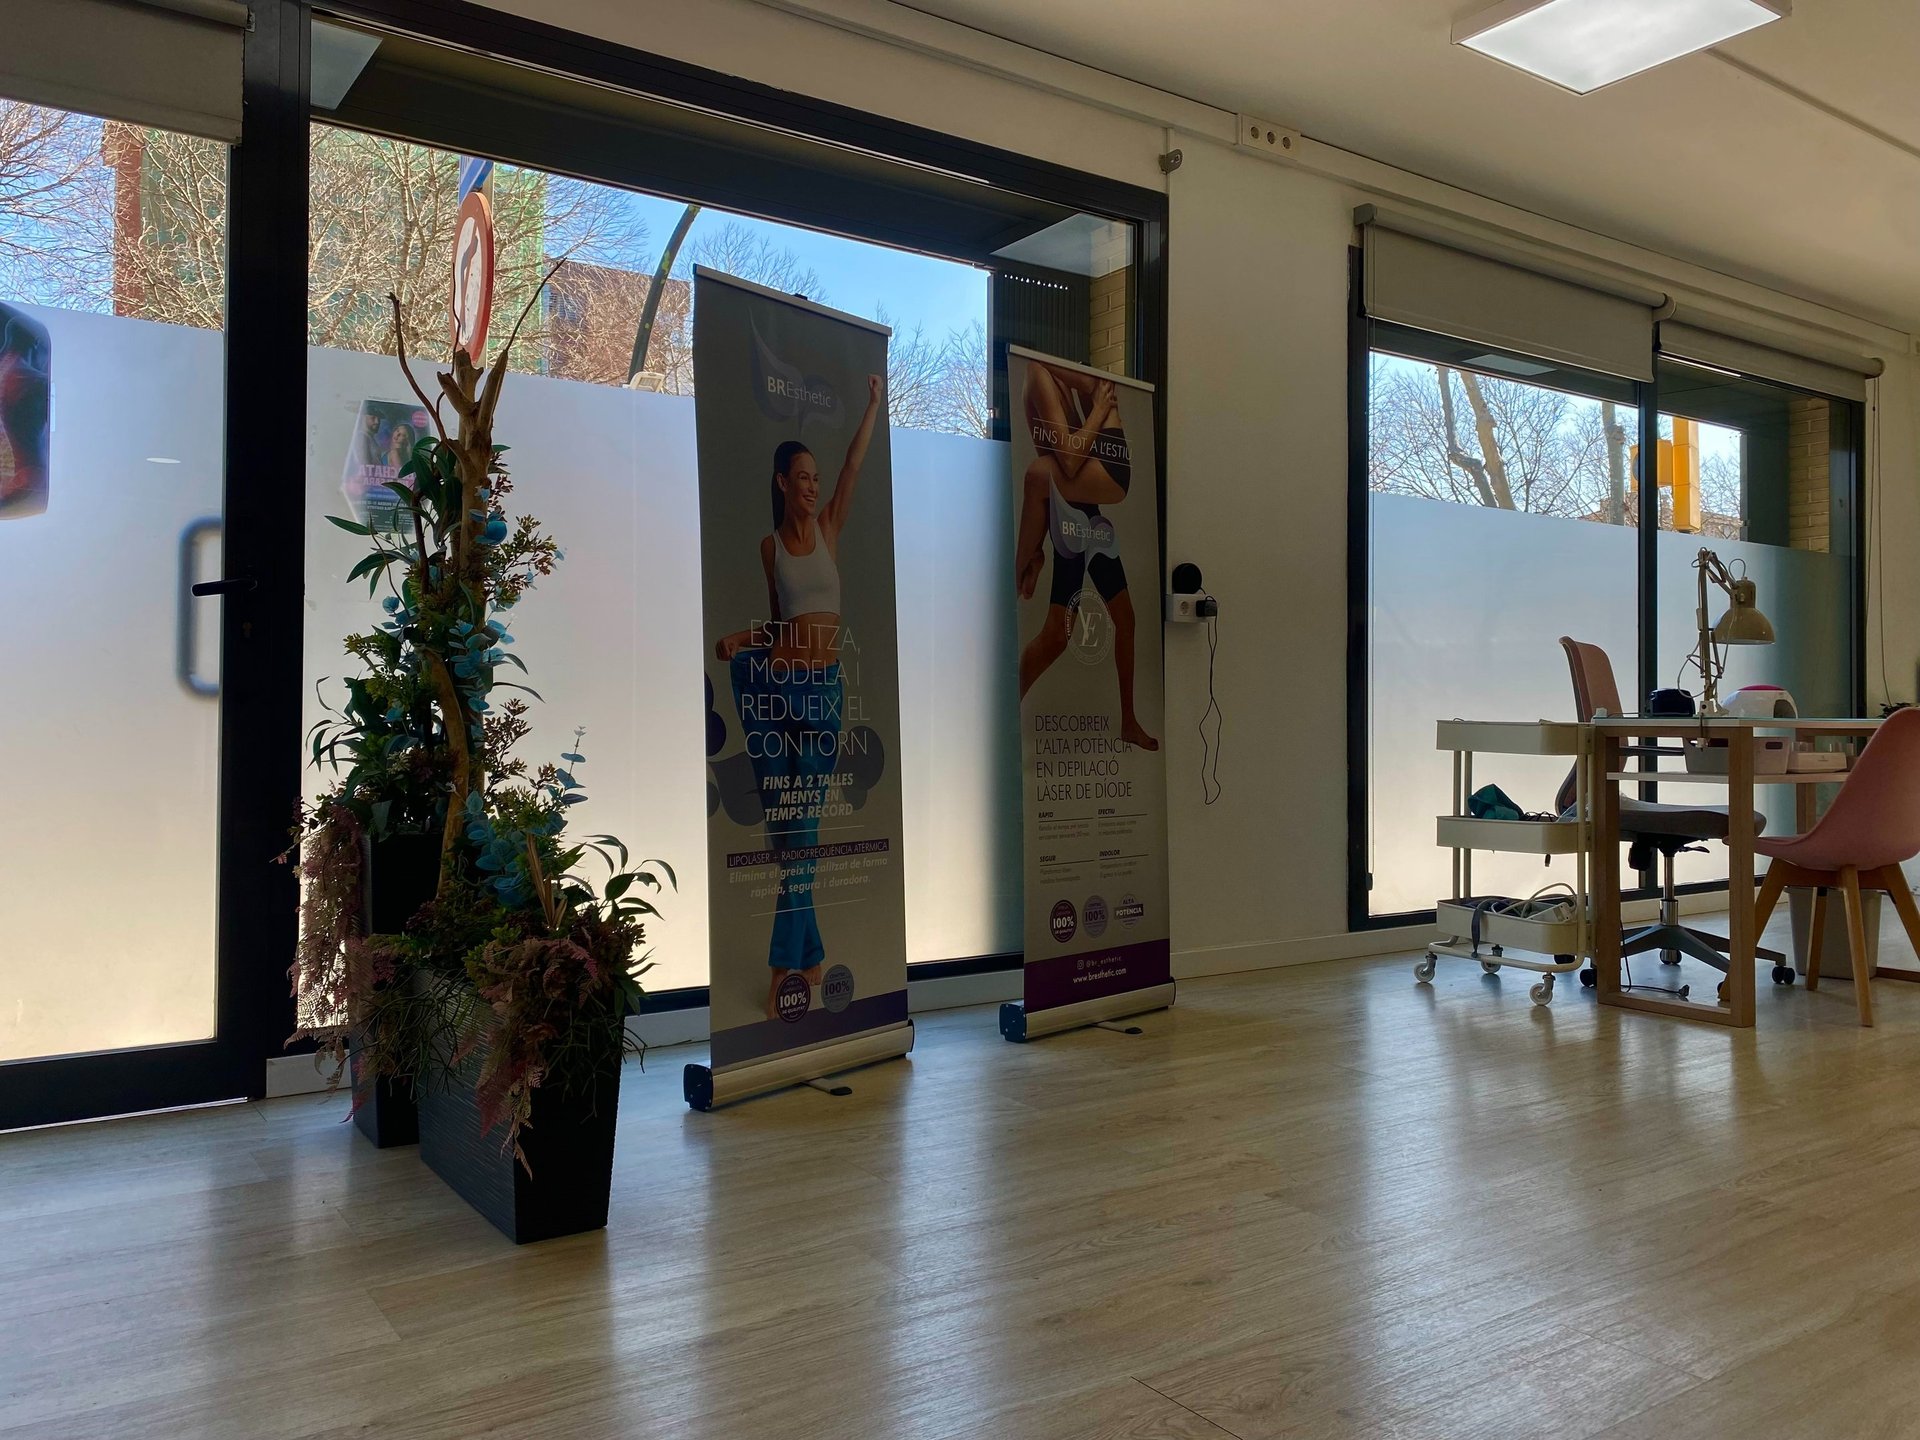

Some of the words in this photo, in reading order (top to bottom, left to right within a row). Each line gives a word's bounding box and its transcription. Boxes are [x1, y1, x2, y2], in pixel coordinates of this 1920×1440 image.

[767, 375, 832, 408] BREsthetic
[1032, 426, 1058, 445] FINS
[1066, 435, 1088, 450] TOT
[1089, 440, 1098, 453] A
[1062, 521, 1112, 542] BREsthetic
[750, 619, 861, 655] ESTILITZA,
[750, 656, 849, 686] MODELA
[741, 694, 841, 721] REDUEIX
[848, 696, 871, 721] EL
[1035, 715, 1110, 733] DESCOBREIX
[745, 730, 868, 758] CONTORN
[1035, 738, 1071, 755] L'ALTA
[1074, 733, 1133, 754] POTÈNCIA
[1036, 761, 1054, 778] EN
[1057, 756, 1119, 778] DEPILACIÓ
[762, 775, 790, 790] FINS
[793, 776, 803, 788] A
[806, 774, 814, 788] 2
[817, 773, 853, 787] TALLES
[1037, 779, 1072, 802] LÀSER
[1077, 783, 1091, 799] DE
[1095, 778, 1132, 799] DÍODE
[779, 790, 821, 805] MENYS
[824, 789, 840, 802] EN
[764, 807, 804, 823] TEMPS
[807, 803, 854, 819] RECORD
[1039, 855, 1056, 863] SEGUR
[729, 870, 766, 884] Elimina
[769, 867, 778, 879] el
[780, 865, 804, 880] greix
[850, 858, 860, 869] de
[863, 857, 888, 867] forma
[788, 882, 821, 894] segura
[1053, 915, 1074, 930] 100%
[1085, 909, 1106, 922] 100%
[1072, 968, 1127, 984] www.bresthetic.com
[824, 980, 850, 996] 100%
[779, 990, 807, 1009] 100%
